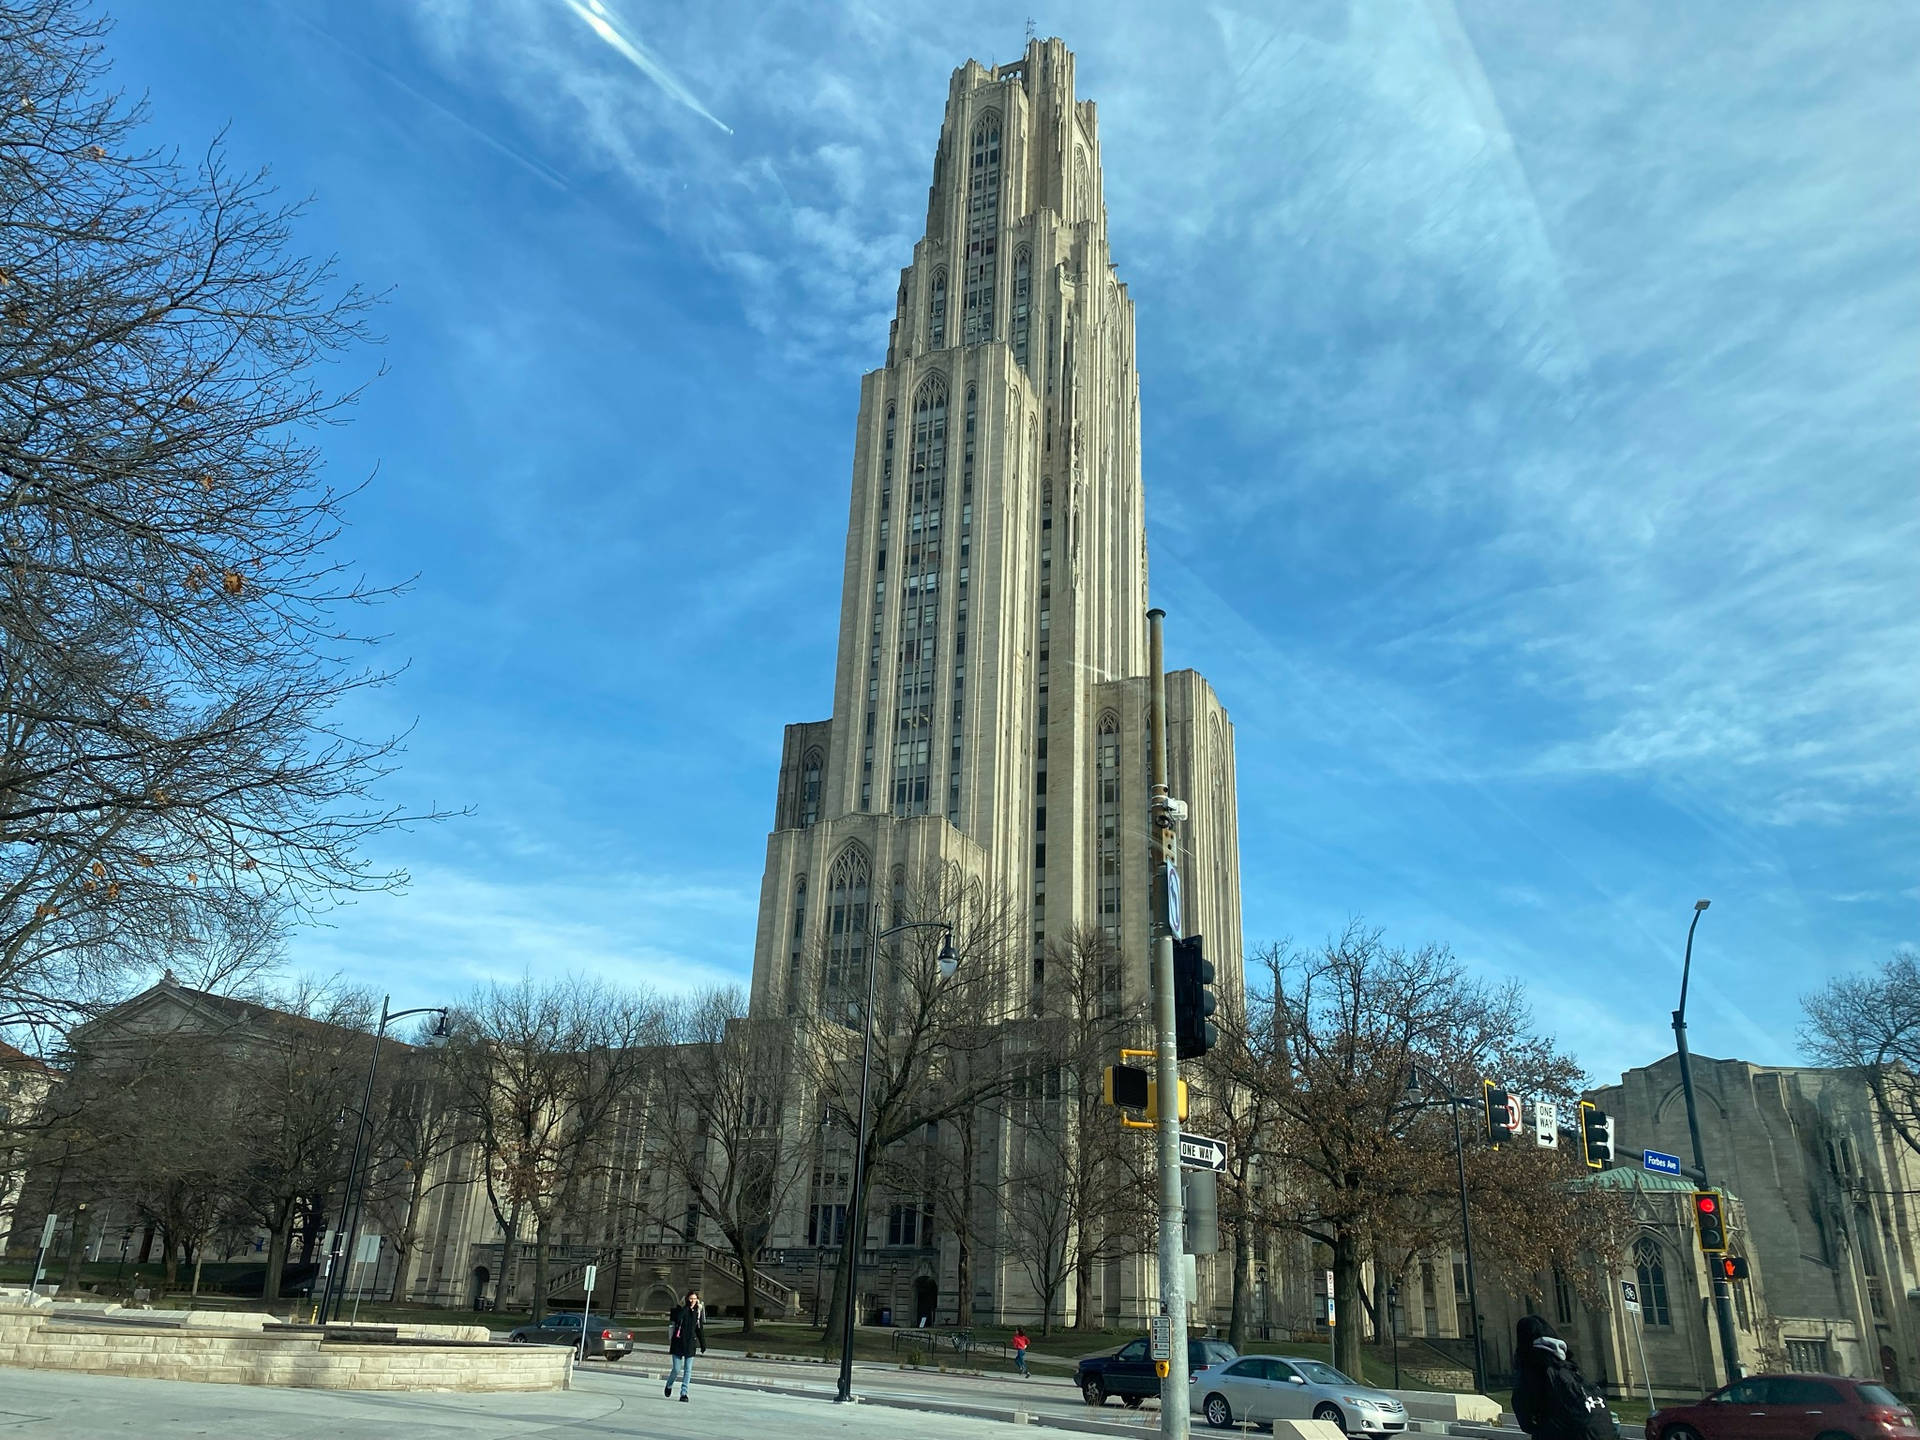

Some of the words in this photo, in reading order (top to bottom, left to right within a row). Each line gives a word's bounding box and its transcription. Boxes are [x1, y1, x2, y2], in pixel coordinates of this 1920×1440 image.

[1540, 1105, 1552, 1117] ONE
[1540, 1117, 1553, 1128] WAY
[1182, 1144, 1195, 1156] ONE
[1199, 1147, 1213, 1160] WAY
[1648, 1155, 1665, 1167] Forbes
[1666, 1159, 1677, 1169] Ave
